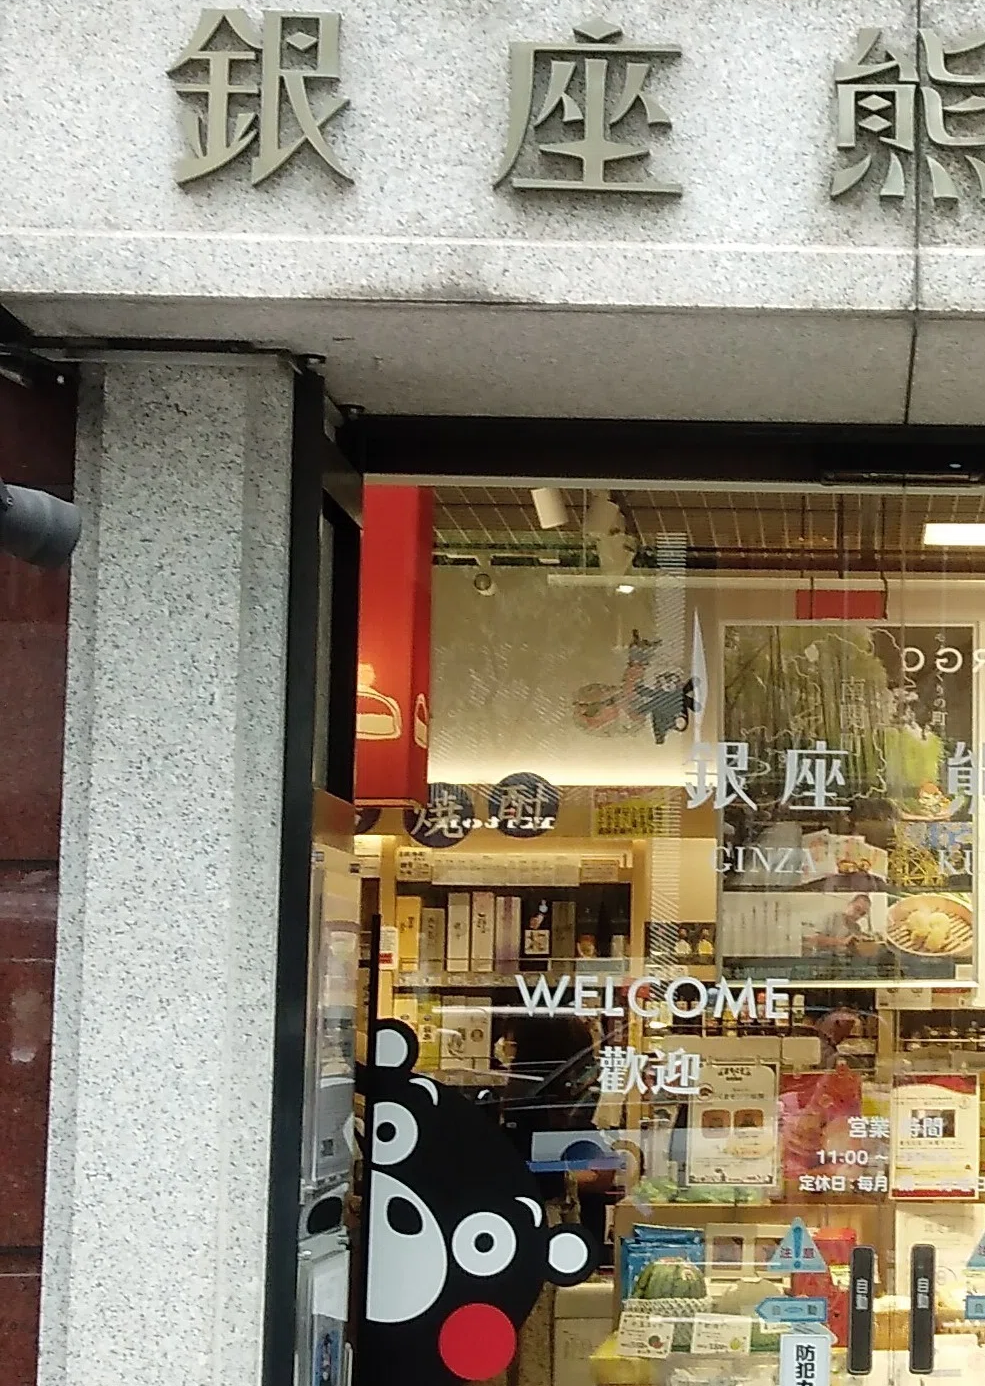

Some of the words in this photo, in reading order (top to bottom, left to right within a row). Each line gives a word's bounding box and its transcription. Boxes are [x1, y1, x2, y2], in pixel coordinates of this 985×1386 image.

[685, 740, 851, 812] 銀座
[712, 845, 817, 875] GINZA
[516, 974, 790, 1019] WELCOME
[816, 1150, 869, 1165] 11:00
